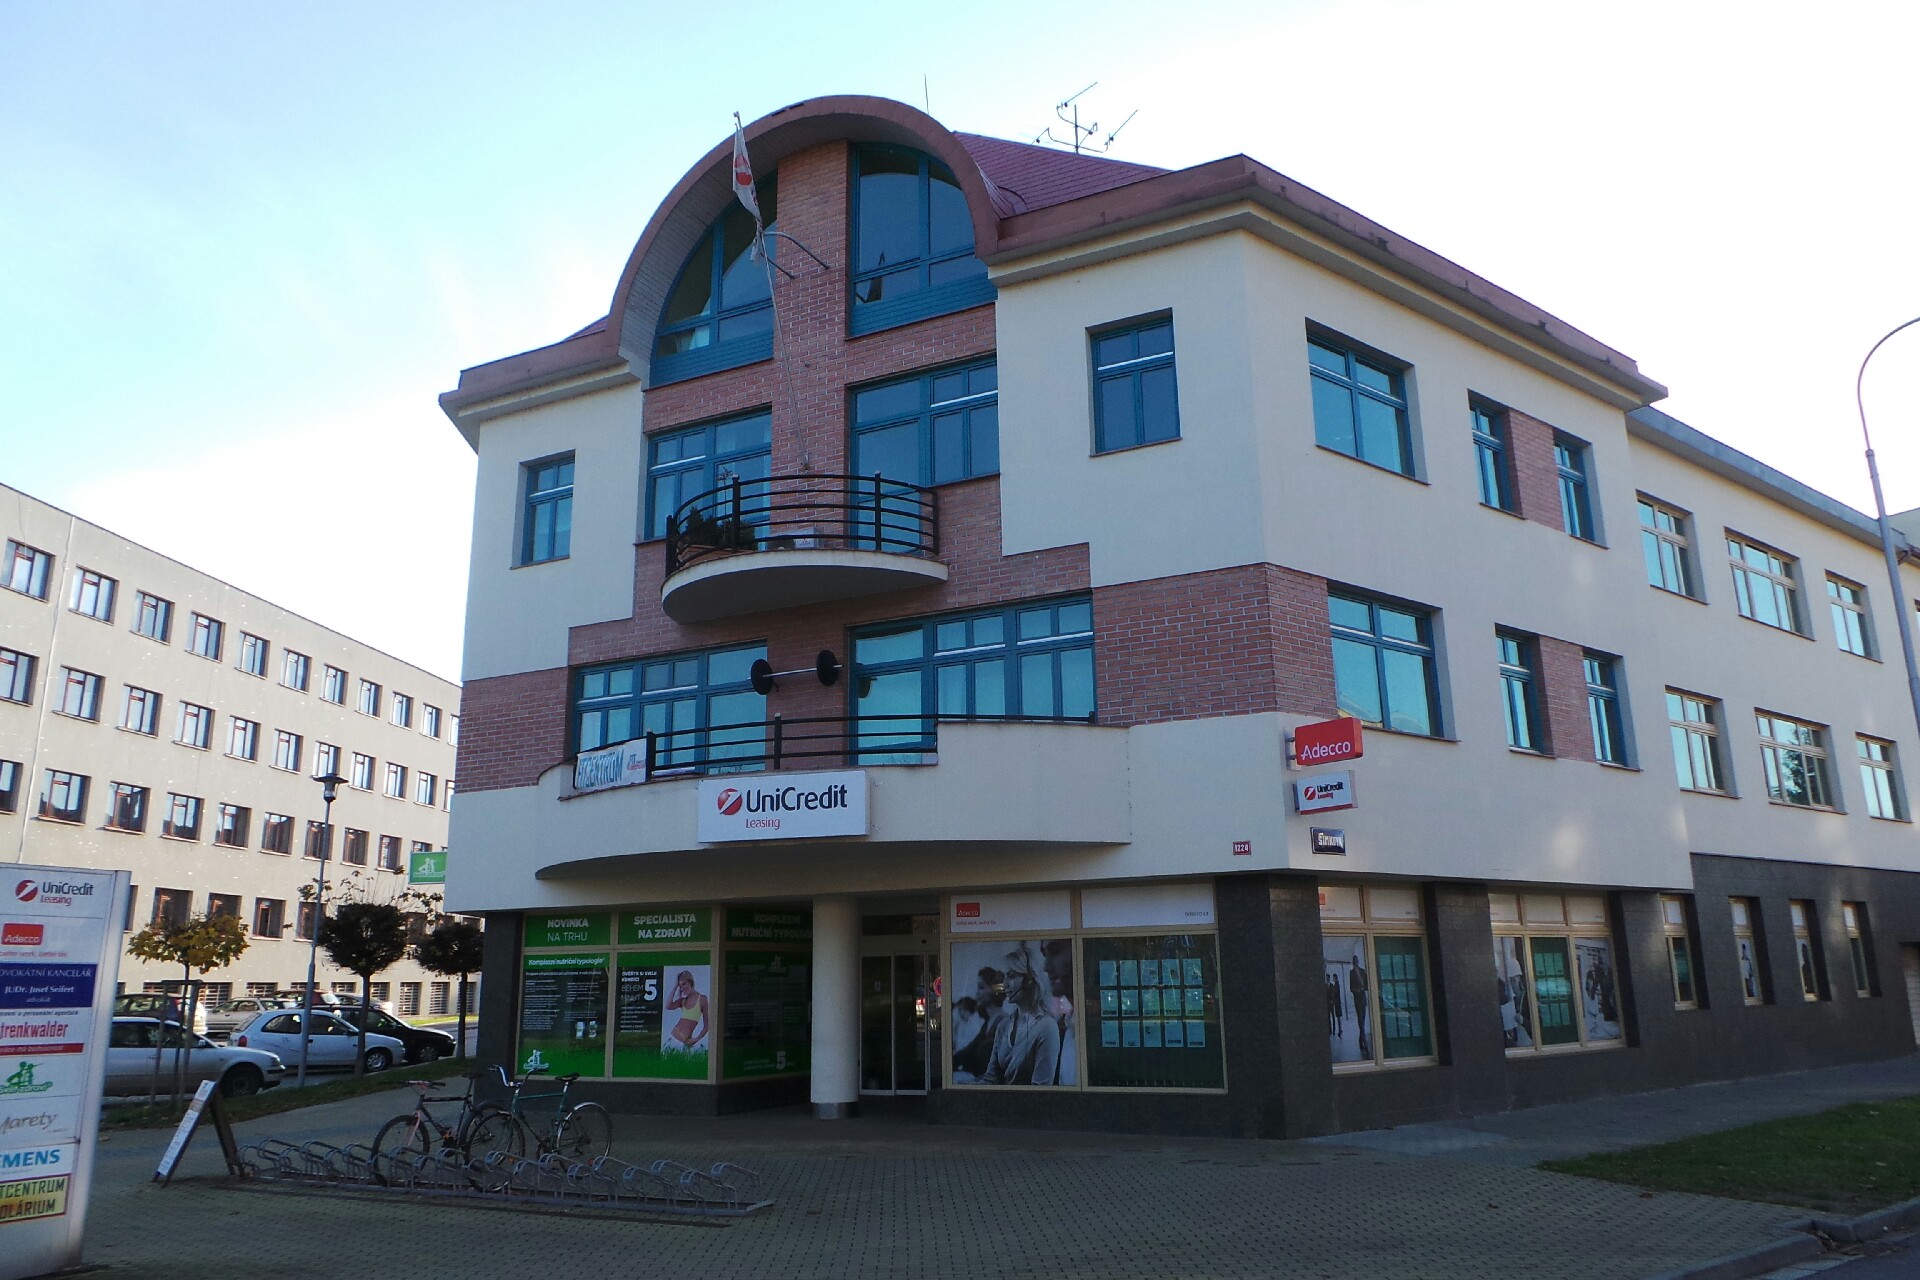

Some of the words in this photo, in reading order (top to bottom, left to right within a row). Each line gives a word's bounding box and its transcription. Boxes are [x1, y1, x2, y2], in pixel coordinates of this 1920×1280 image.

[1301, 741, 1351, 760] Adecco
[1317, 781, 1344, 793] UniCredit
[746, 784, 848, 812] UniCredit
[1317, 791, 1334, 800] Leasing
[745, 817, 780, 830] Leasing
[42, 881, 95, 896] UniCredit
[40, 895, 72, 906] Leasing
[547, 918, 589, 929] NOVINKA
[633, 914, 697, 926] SPECIALISTA
[547, 933, 561, 942] NA
[563, 932, 588, 942] TRHU
[638, 929, 652, 939] NA
[654, 925, 692, 938] ZDRAVÍ
[4, 933, 40, 944] Adecco
[47, 968, 92, 977] KANCELÁŘ
[5, 985, 28, 994] JUDr.
[29, 985, 49, 994] Josef
[50, 985, 75, 993] Seifert
[643, 978, 658, 1001] 5
[776, 1050, 786, 1070] 5
[0, 1149, 61, 1169] MENS
